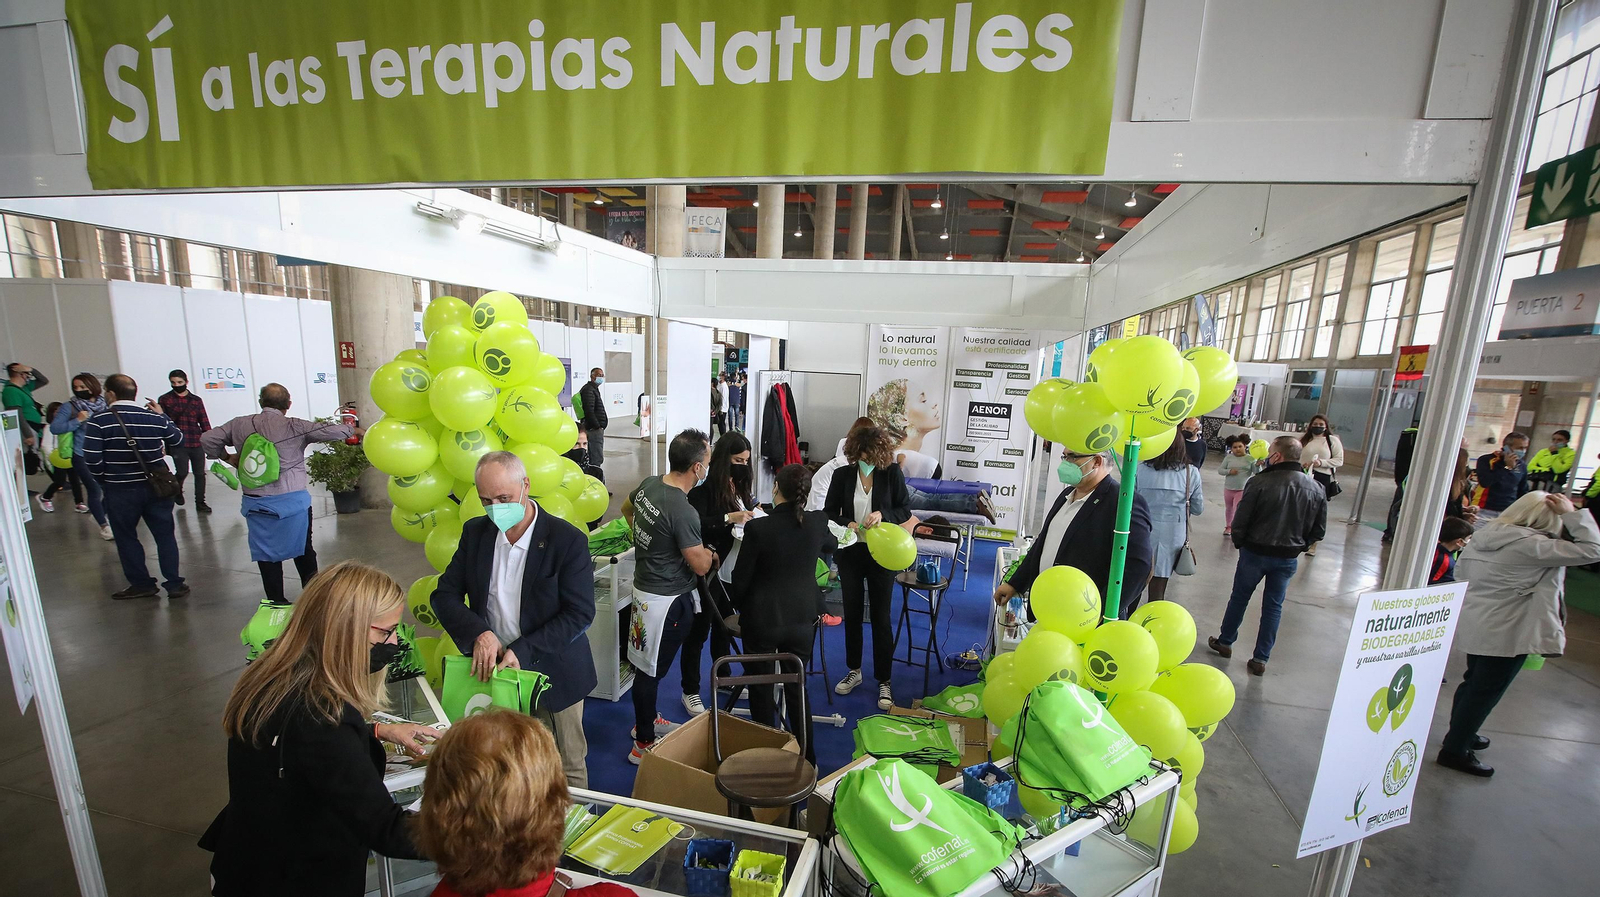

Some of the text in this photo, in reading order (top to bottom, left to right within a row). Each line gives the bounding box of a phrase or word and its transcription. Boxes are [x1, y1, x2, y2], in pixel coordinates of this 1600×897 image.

[201, 65, 234, 111] a
[248, 52, 326, 107] las
[336, 18, 633, 108] Terapias
[660, 2, 1074, 87] Naturales
[687, 215, 722, 226] IFECA
[1515, 293, 1585, 315] PUERTA 2
[882, 333, 936, 344] Lo natural
[963, 335, 1031, 347] Nuestra calidad
[879, 345, 938, 356] lo llevamos
[965, 345, 1027, 355] está certificada
[878, 358, 937, 368] muy dentro
[987, 362, 1028, 370] Profesionalidad
[202, 367, 245, 379] IFECA
[957, 369, 992, 378] Transparencia
[1008, 372, 1028, 380] Gestión
[955, 381, 980, 390] Liderazgo
[1006, 388, 1030, 396] Serieda
[971, 404, 1008, 416] AENOR
[948, 444, 973, 452] Confianza
[1371, 592, 1454, 611] Nuestros globos son
[1365, 606, 1451, 633] naturalmente
[1361, 626, 1446, 651] BIODEGRADABLES
[1356, 640, 1442, 669] y nuestras varillas también
[1377, 804, 1409, 824] Cofenat
[915, 875, 923, 885] Lo
[922, 864, 941, 879] Natural
[945, 856, 959, 868] estar
